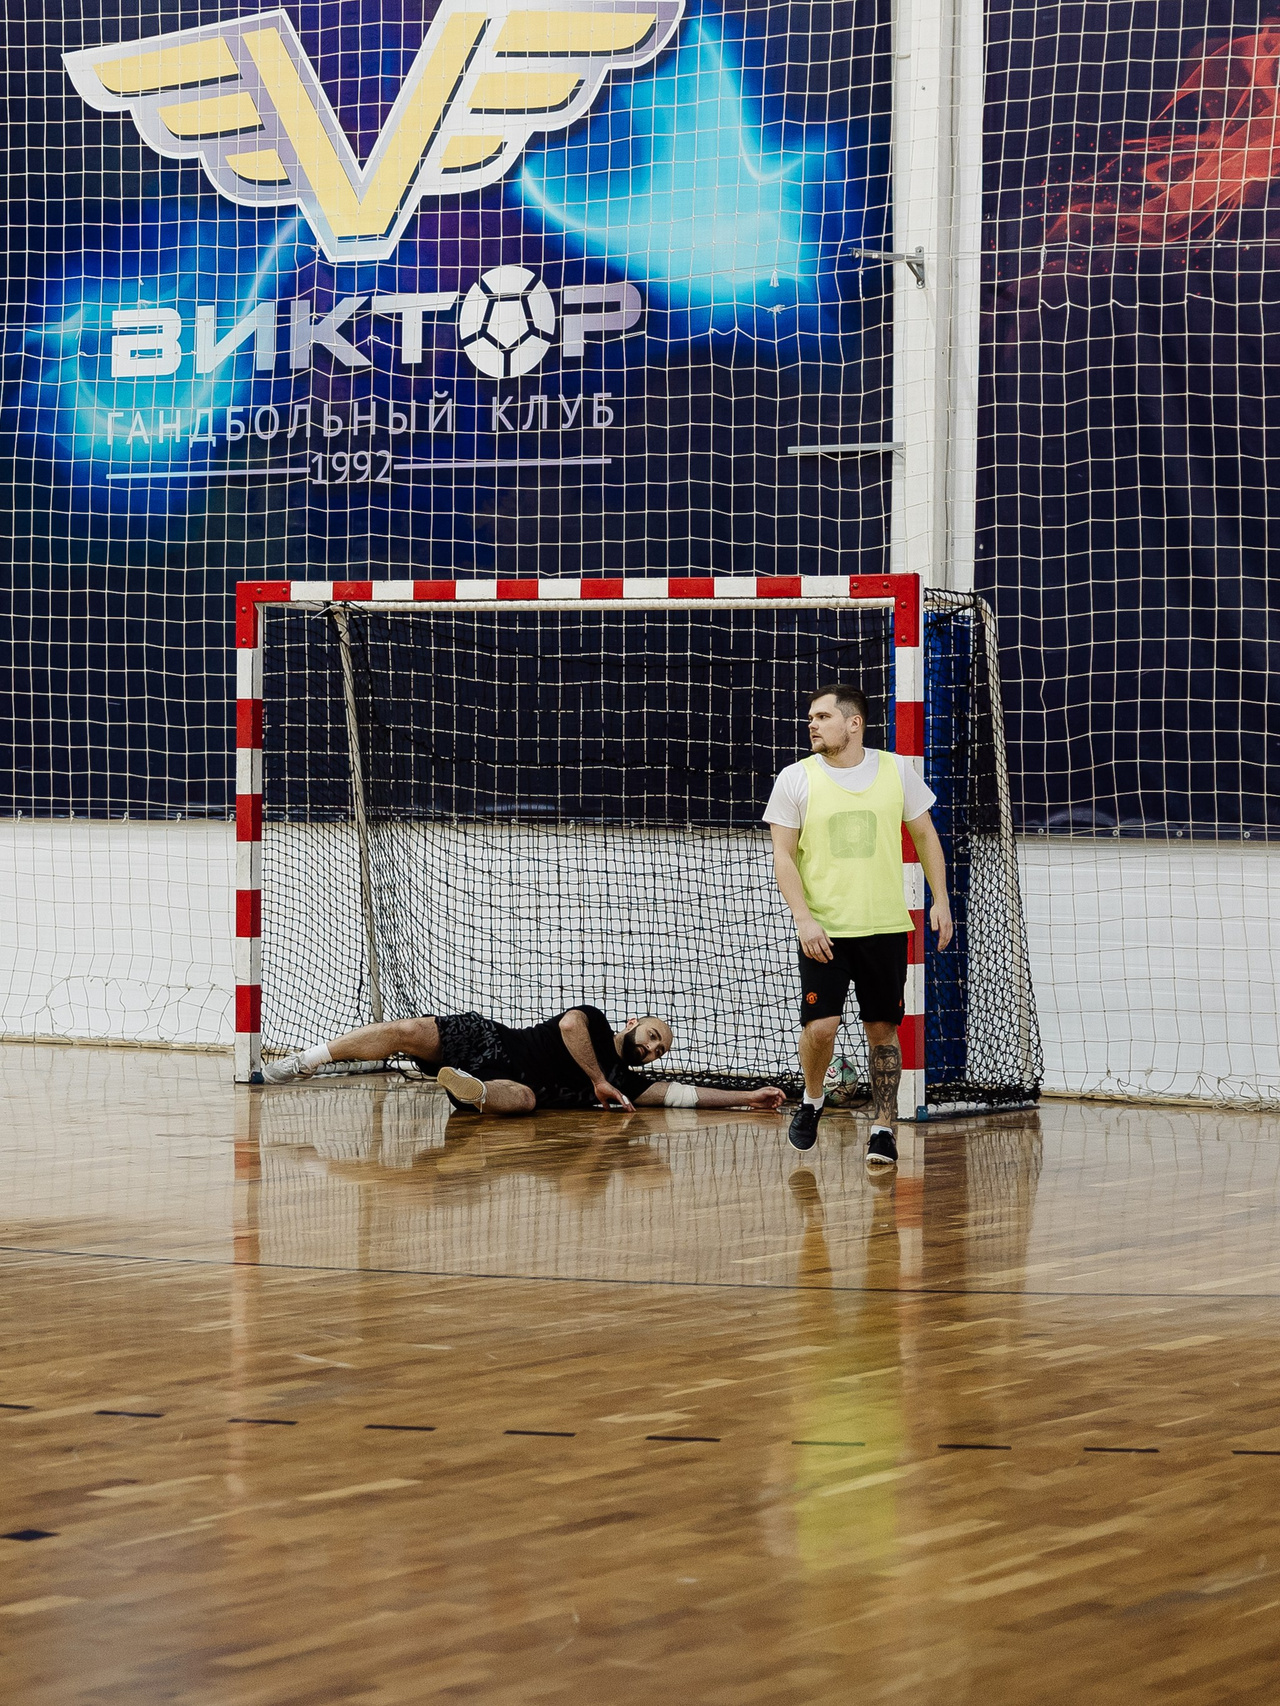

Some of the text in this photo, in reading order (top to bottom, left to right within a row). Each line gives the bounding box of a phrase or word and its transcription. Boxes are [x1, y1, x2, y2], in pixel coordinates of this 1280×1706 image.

[111, 265, 642, 380] ВИКТОР
[106, 391, 615, 450] ГАНДБОЛЬНЫЙ КЛУБ
[311, 450, 393, 486] 1992
